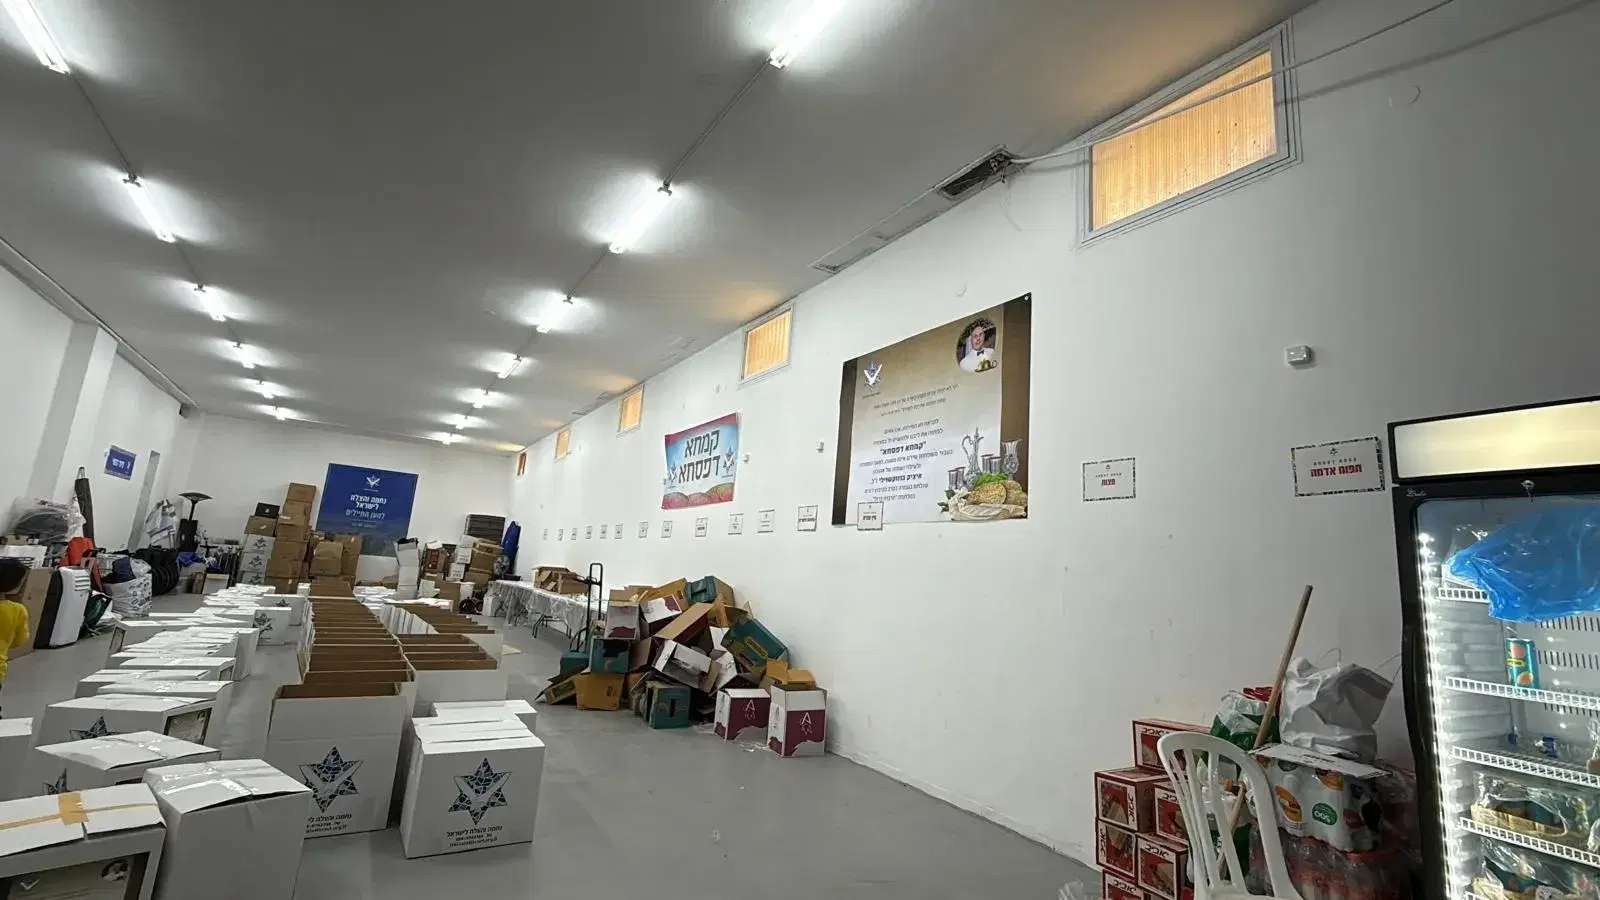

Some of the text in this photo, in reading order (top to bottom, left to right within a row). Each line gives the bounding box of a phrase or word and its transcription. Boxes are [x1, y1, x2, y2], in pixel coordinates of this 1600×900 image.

[684, 429, 720, 458] קמחא
[880, 440, 926, 456] "קמחא דפסחא"
[679, 455, 721, 483] דפסחא
[1311, 464, 1362, 477] תפוח אדמה
[350, 494, 387, 504] נחמה והצלה
[356, 501, 379, 510] לישראל
